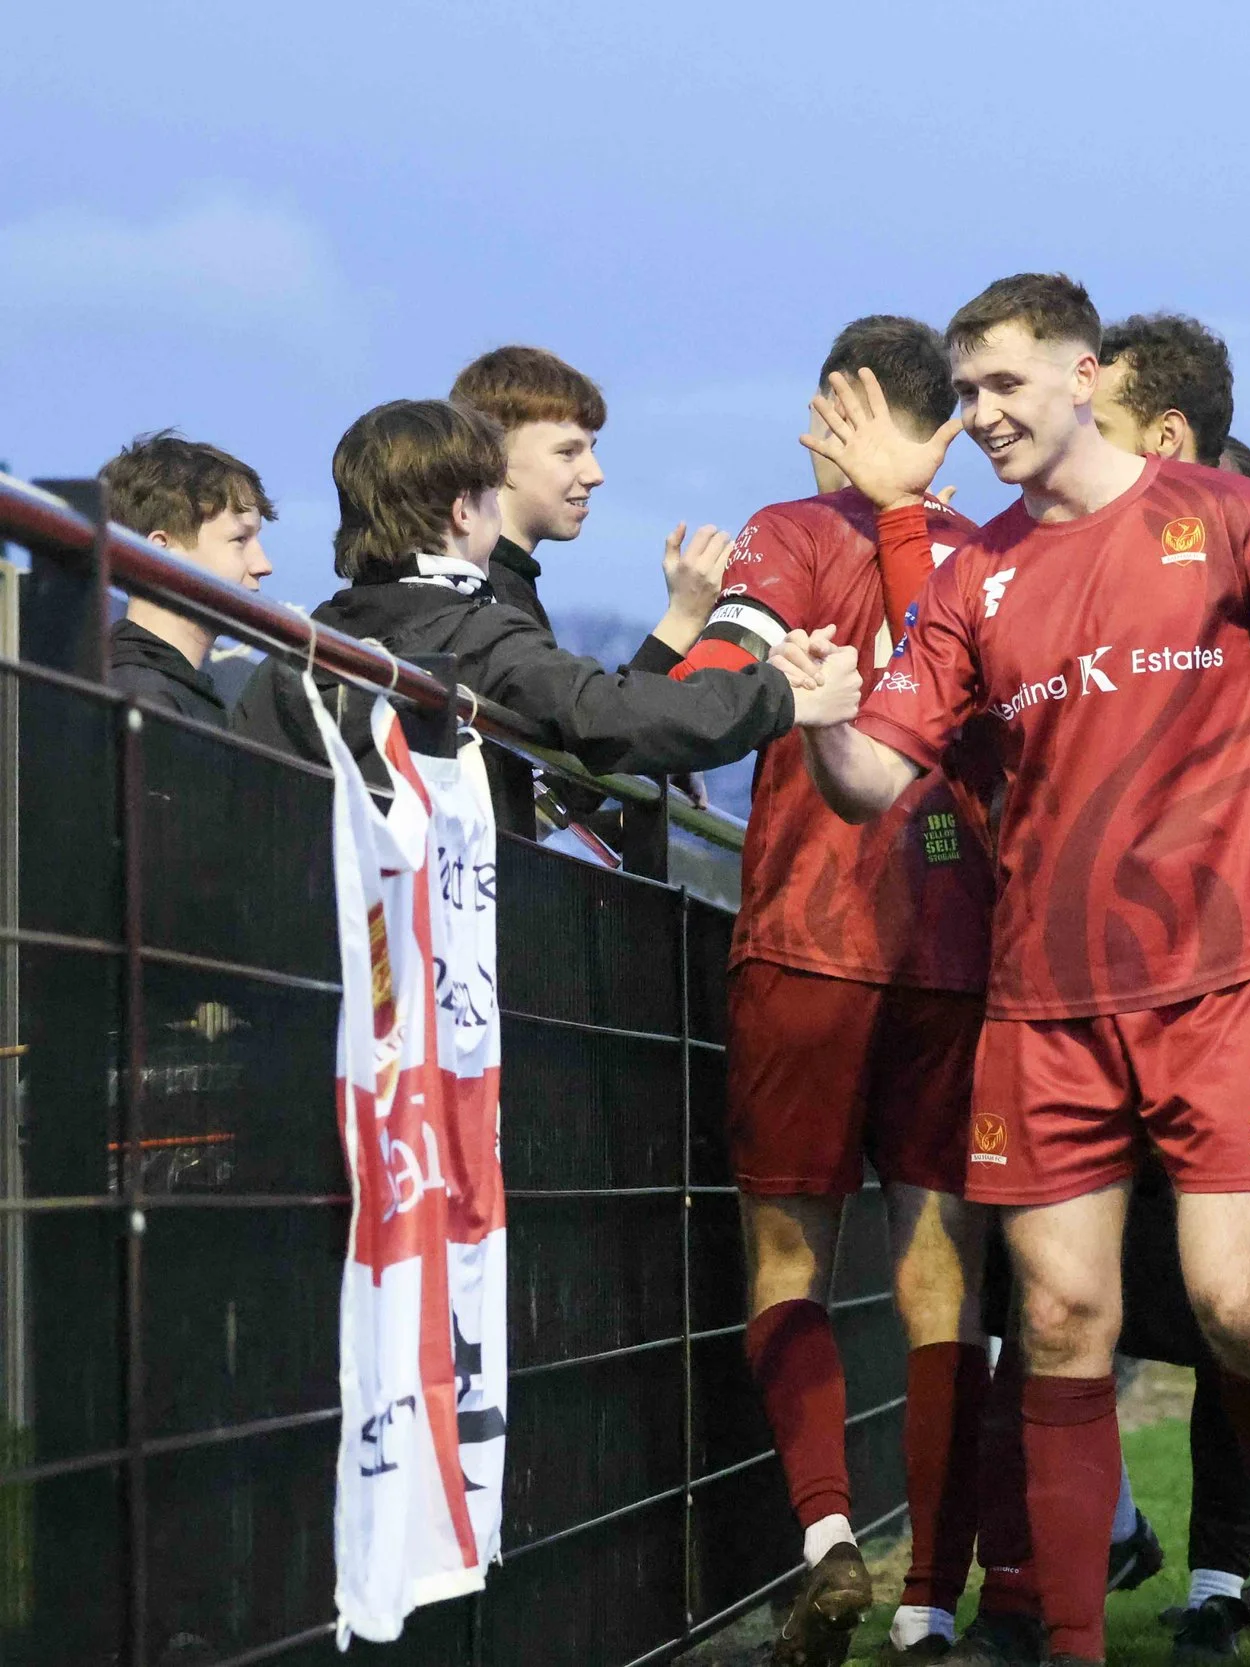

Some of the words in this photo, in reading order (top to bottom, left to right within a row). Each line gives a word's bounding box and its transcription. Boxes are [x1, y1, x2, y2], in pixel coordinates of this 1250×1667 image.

[711, 606, 744, 620] TAIN
[1131, 645, 1224, 674] Estates
[927, 813, 955, 830] BIG
